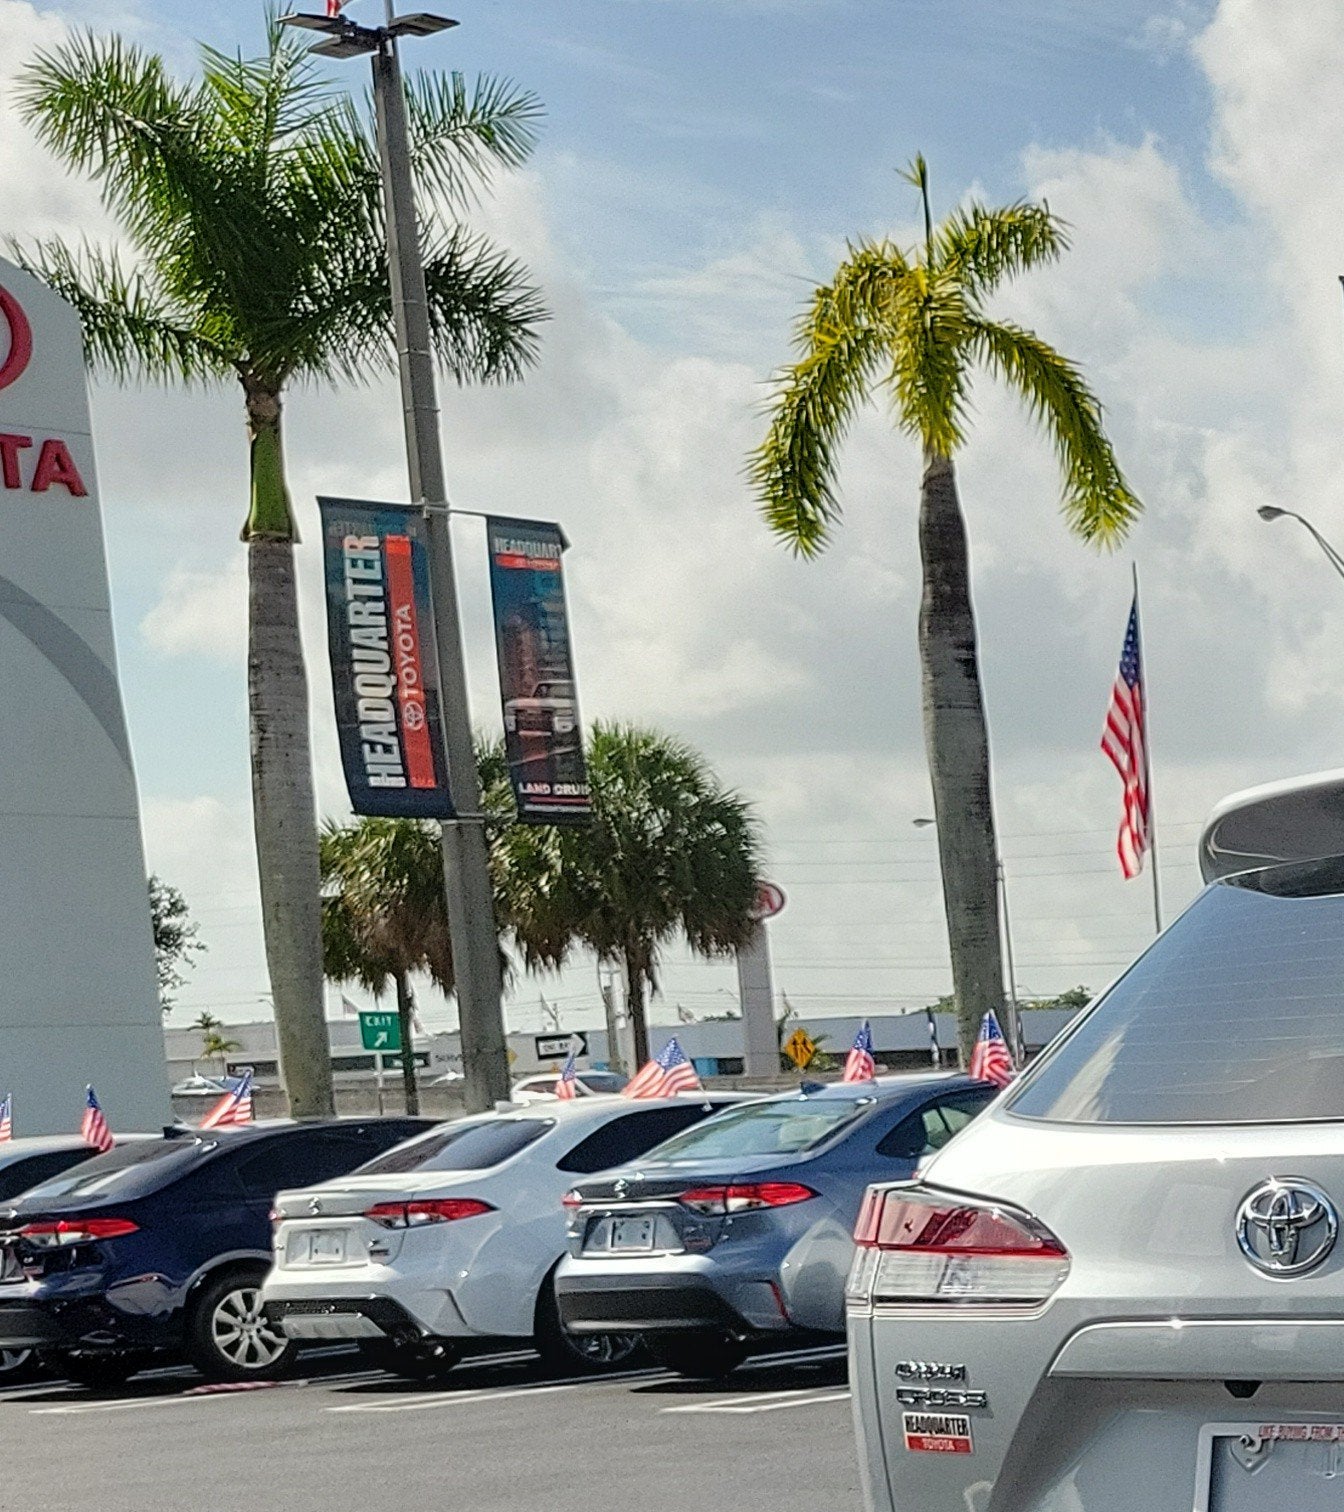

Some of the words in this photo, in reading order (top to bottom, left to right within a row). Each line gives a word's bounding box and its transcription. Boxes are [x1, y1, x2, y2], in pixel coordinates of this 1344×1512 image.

[394, 604, 419, 699] TOYOTA
[343, 534, 407, 788] HEADQUARTER
[519, 782, 551, 795] LAND
[365, 1015, 392, 1027] EXIT
[904, 1414, 970, 1436] HEADQUARTER
[921, 1437, 956, 1451] TOYOTA
